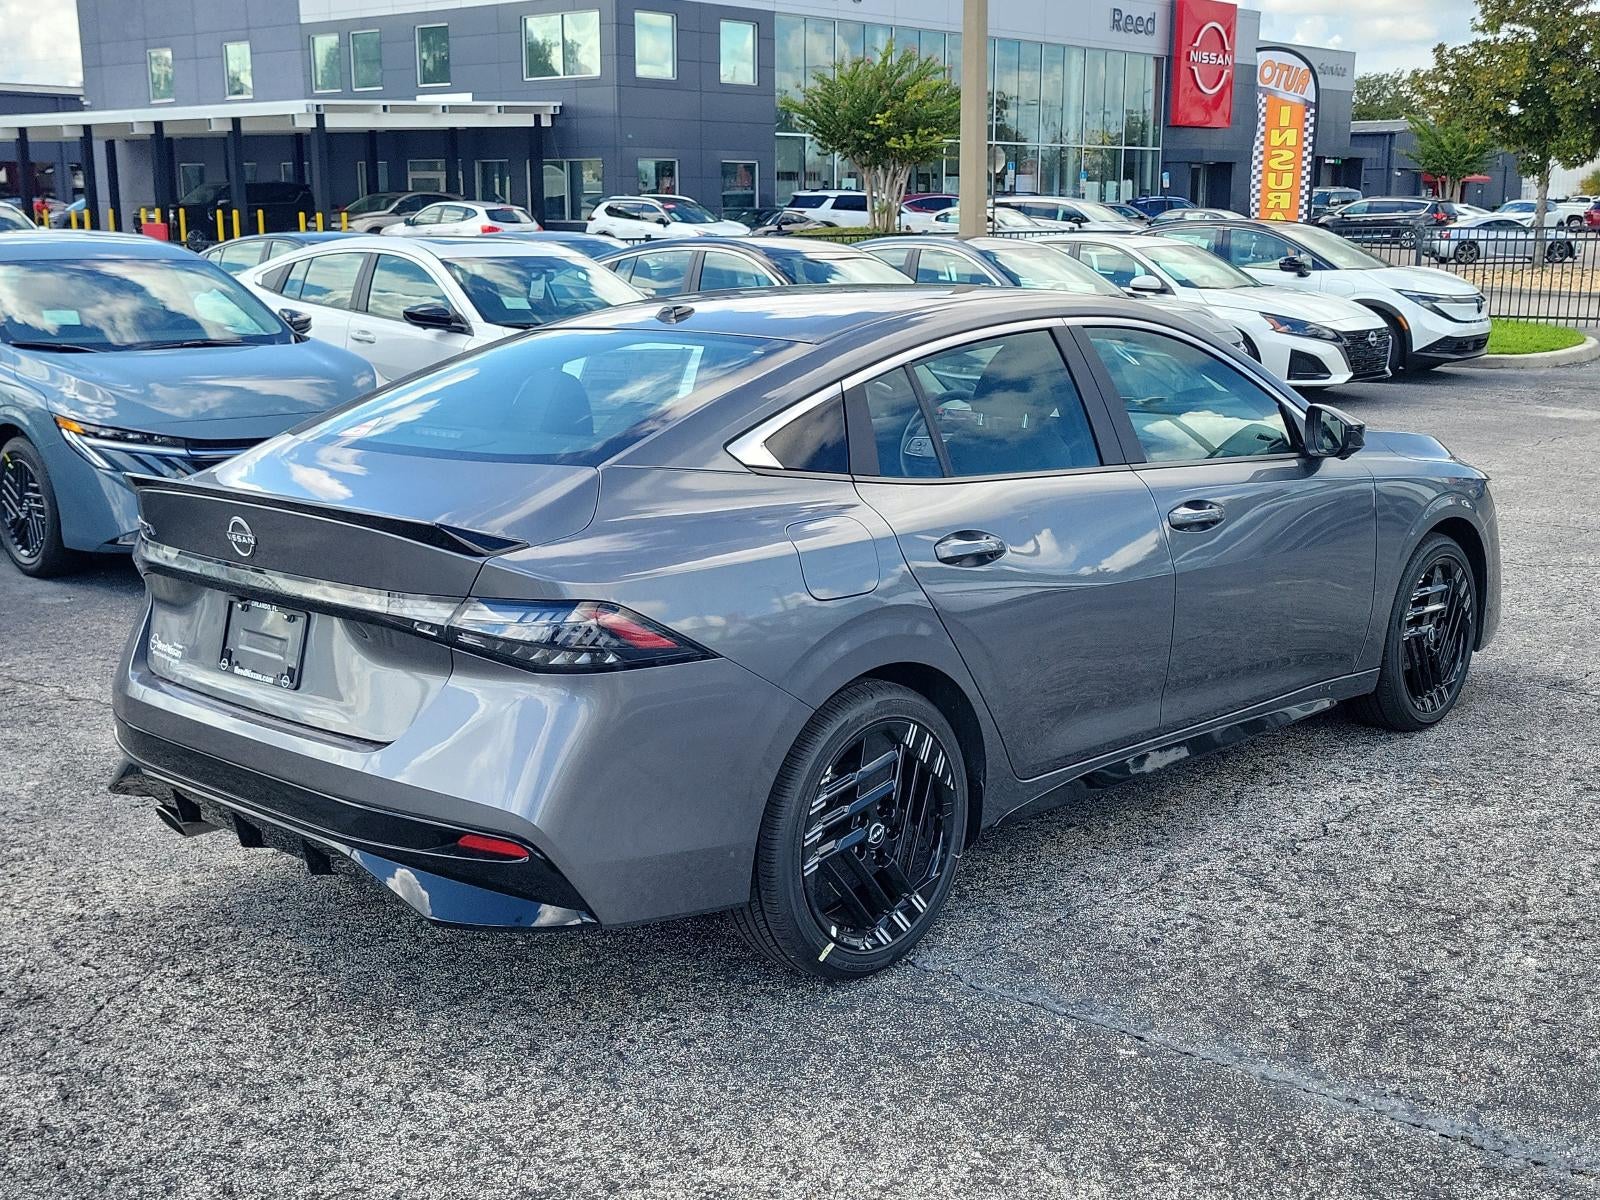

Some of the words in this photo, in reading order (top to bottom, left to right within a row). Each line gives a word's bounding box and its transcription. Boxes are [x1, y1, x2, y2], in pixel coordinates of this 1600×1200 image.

[1110, 8, 1156, 36] Reed
[1189, 50, 1232, 66] NISSAN
[1318, 62, 1347, 77] Service
[226, 532, 255, 545] NISSAN
